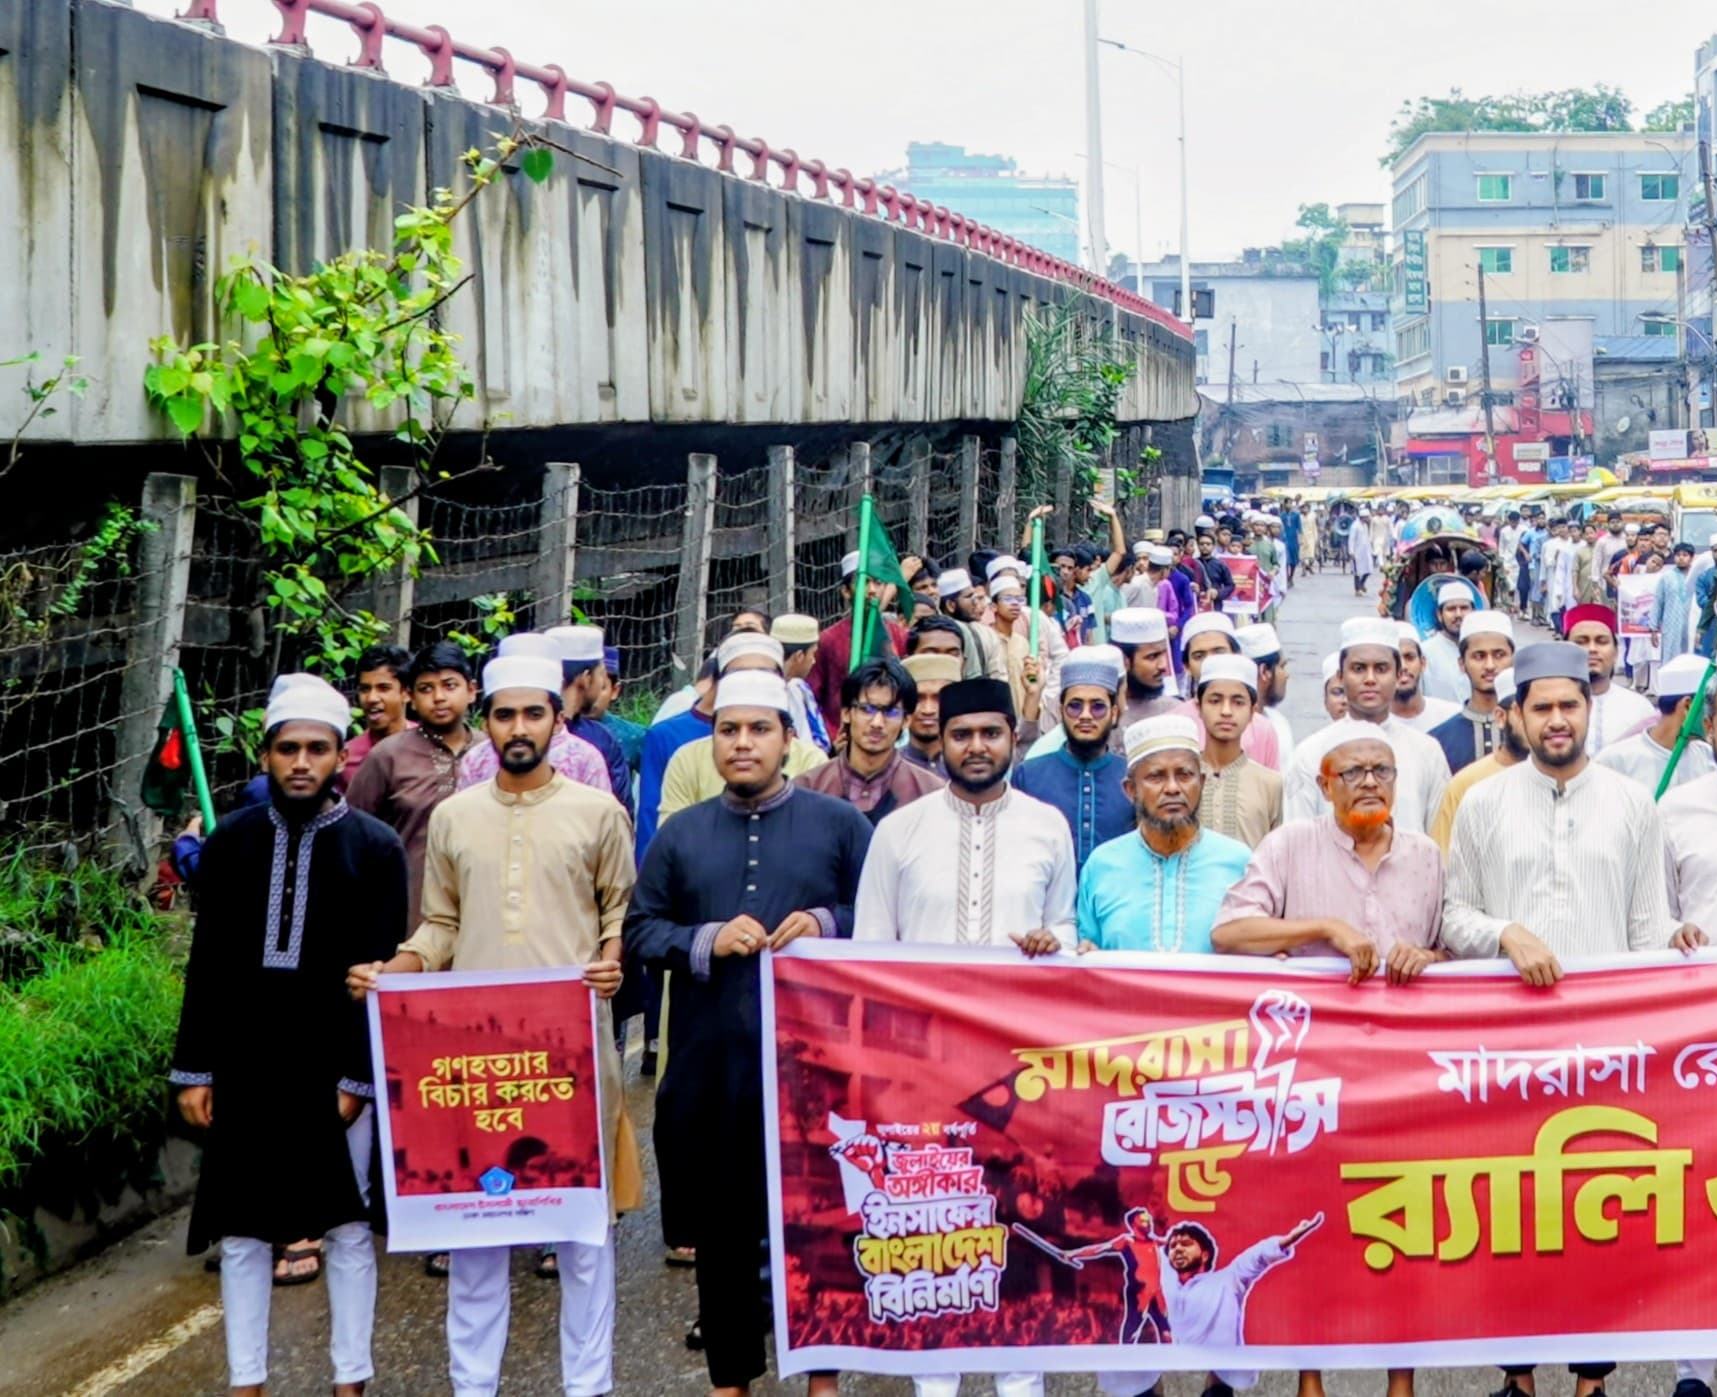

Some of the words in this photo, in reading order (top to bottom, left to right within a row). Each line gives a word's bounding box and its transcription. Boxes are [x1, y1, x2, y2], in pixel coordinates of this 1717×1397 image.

[431, 1050, 549, 1080] গণহত্যার
[1010, 1019, 1250, 1103] মাদরাসা
[1430, 1039, 1658, 1102] মাদরাসা
[418, 1077, 489, 1109] বিচার
[496, 1076, 574, 1104] করতে
[474, 1107, 523, 1133] হবে
[892, 1145, 972, 1174] জুলাইয়ের
[1158, 1144, 1250, 1214] ডে
[862, 1192, 994, 1239] ইনসাফের
[857, 1225, 1006, 1275] বাংলাদেশ
[868, 1261, 998, 1319] বিনির্মাণ
